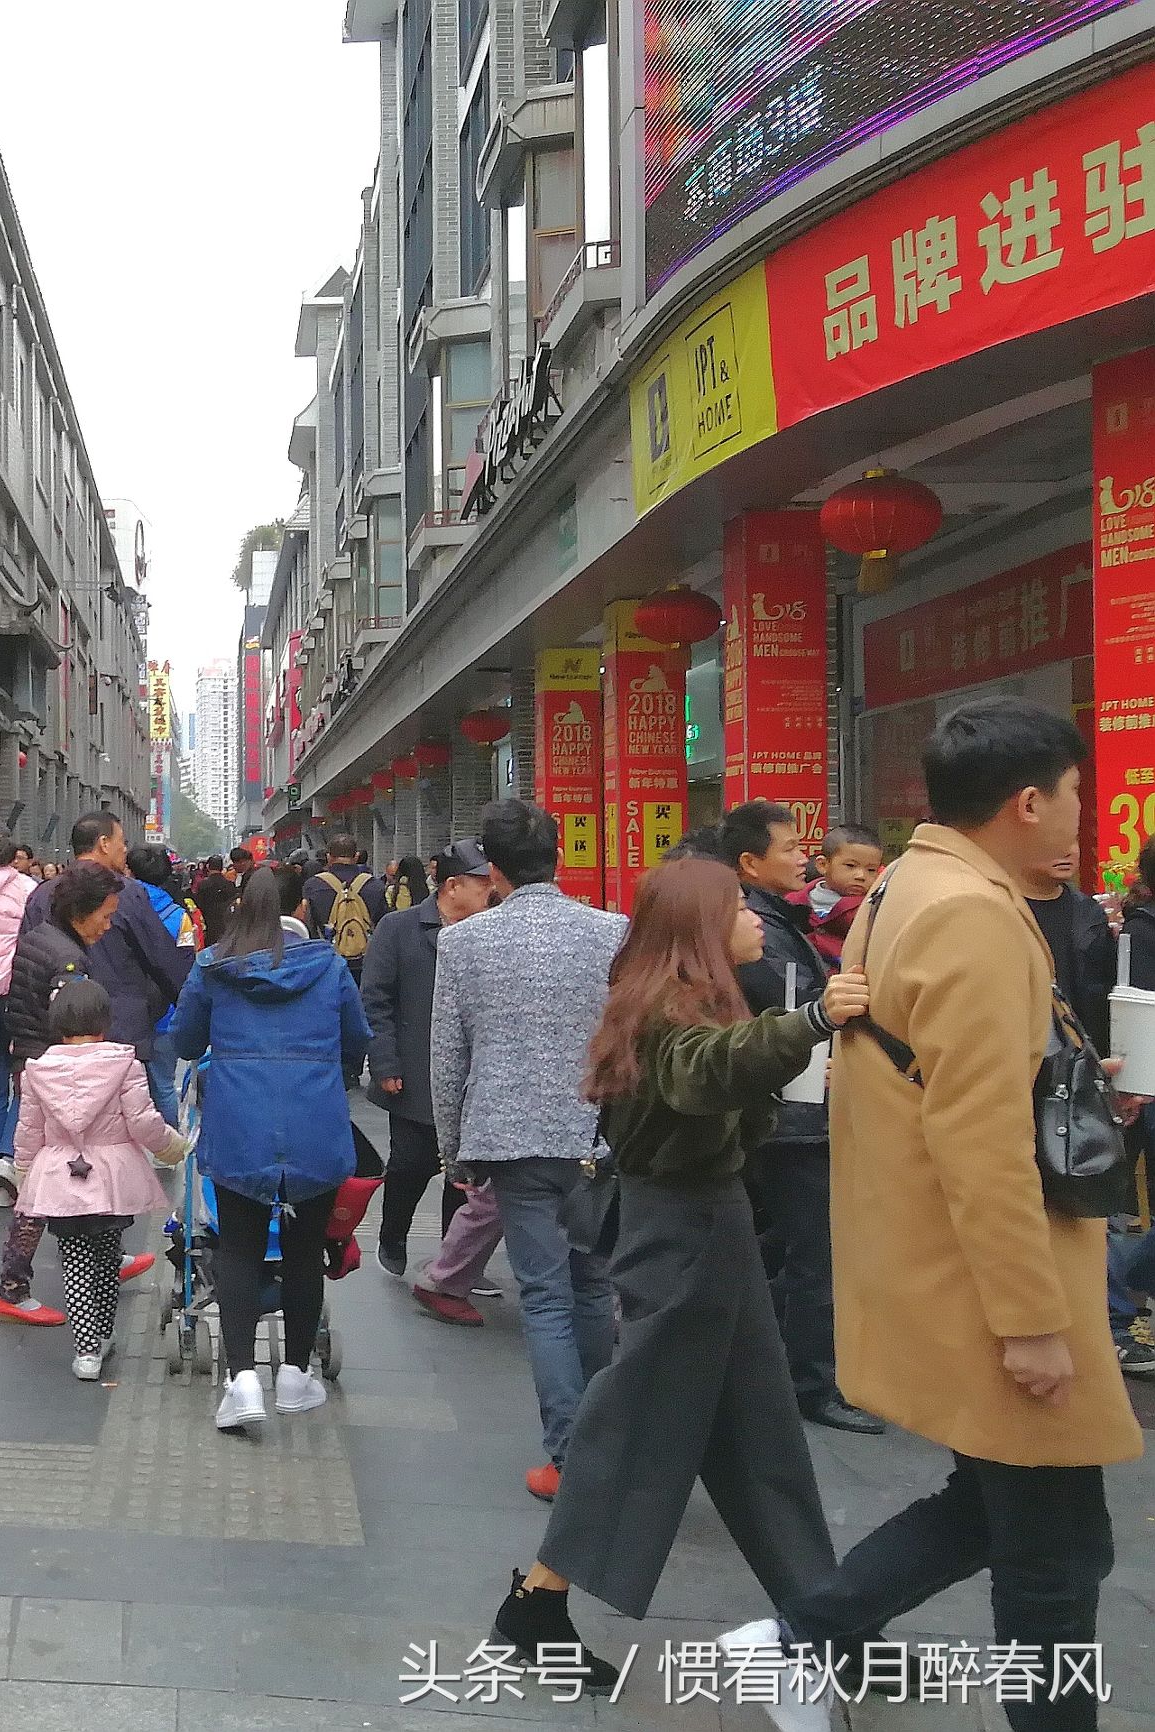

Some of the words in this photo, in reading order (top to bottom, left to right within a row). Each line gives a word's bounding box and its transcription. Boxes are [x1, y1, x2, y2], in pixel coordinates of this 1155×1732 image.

[822, 121, 1155, 361] 品牌进驻
[719, 359, 730, 384] &
[697, 393, 733, 438] HOME
[1100, 513, 1127, 531] LOVE
[1100, 523, 1155, 548] HANDSOME
[1100, 545, 1129, 568] MEN
[753, 621, 778, 632] LOVE
[752, 632, 803, 643] HANDSOME
[753, 643, 779, 657] MEN
[628, 694, 677, 715] 2018
[1100, 700, 1119, 712] JPT
[1121, 696, 1155, 710] HOME
[627, 715, 677, 731] HAPPY
[1099, 713, 1155, 732] 装修前推
[553, 725, 592, 742] 2018
[628, 731, 676, 745] CHINESE
[552, 742, 592, 756] HAPPY
[628, 744, 649, 755] NEW
[652, 744, 677, 754] YEAR
[752, 751, 769, 760] JPT
[771, 751, 802, 760] HOME
[552, 755, 591, 767] CHINESE
[775, 801, 824, 840] 0%
[626, 800, 640, 868] SALE
